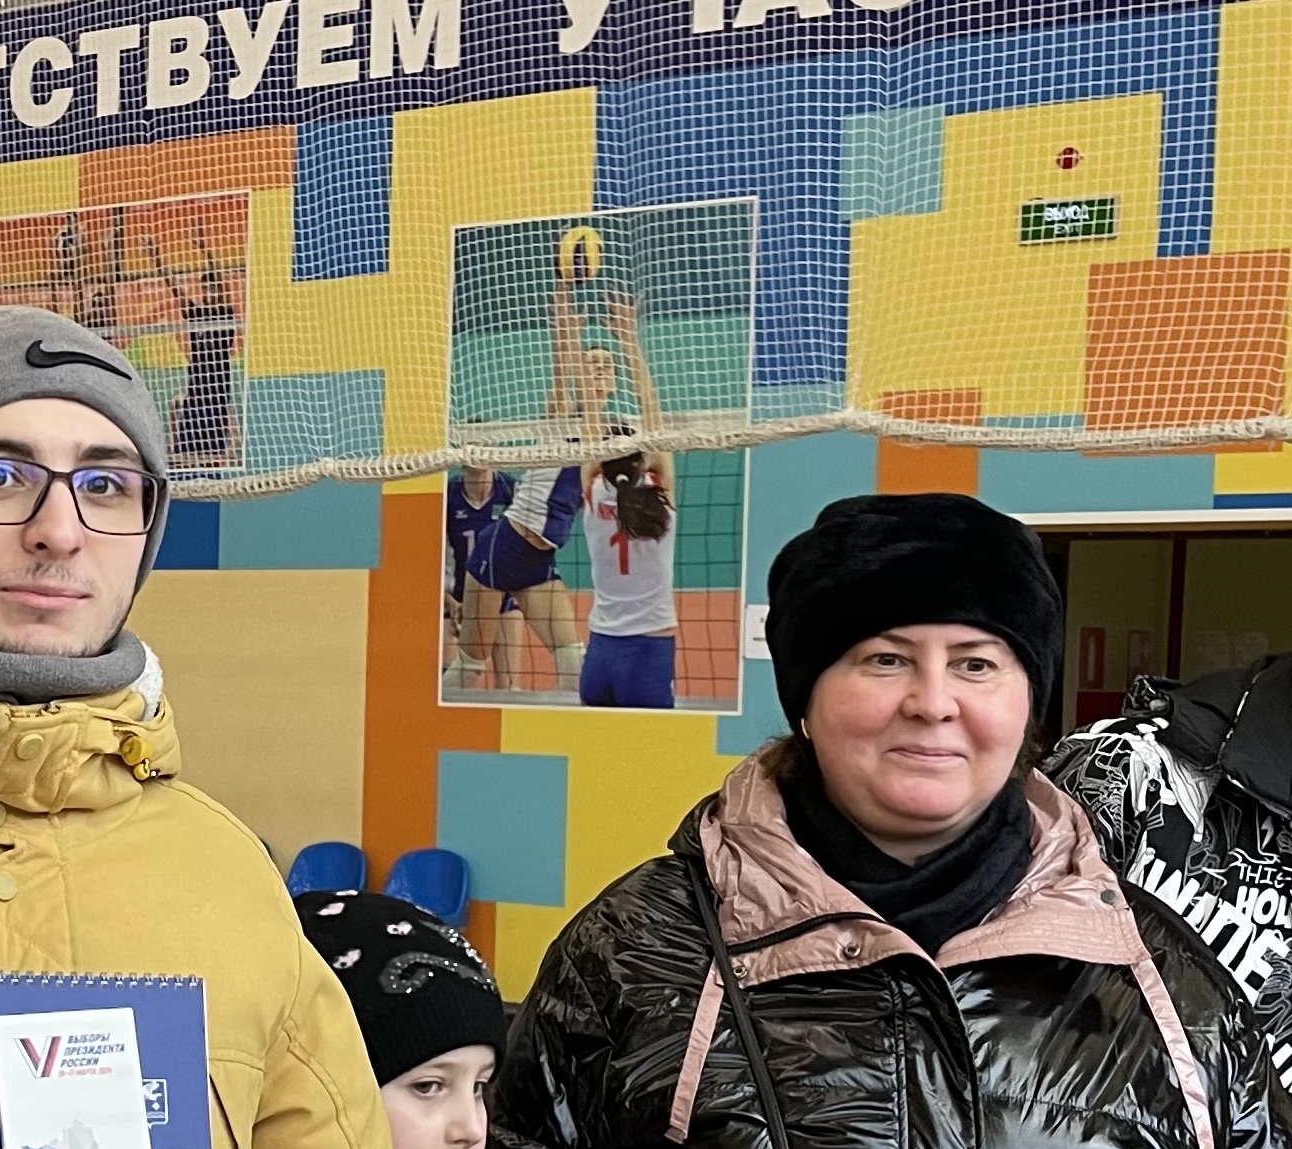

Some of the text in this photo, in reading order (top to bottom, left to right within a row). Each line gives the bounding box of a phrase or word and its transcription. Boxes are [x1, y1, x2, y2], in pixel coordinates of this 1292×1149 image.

[67, 1032, 111, 1044] ВЫБОРЫ
[63, 1043, 125, 1056] ПРЕЗИДЕНТА
[59, 1057, 99, 1068] РОССИИ
